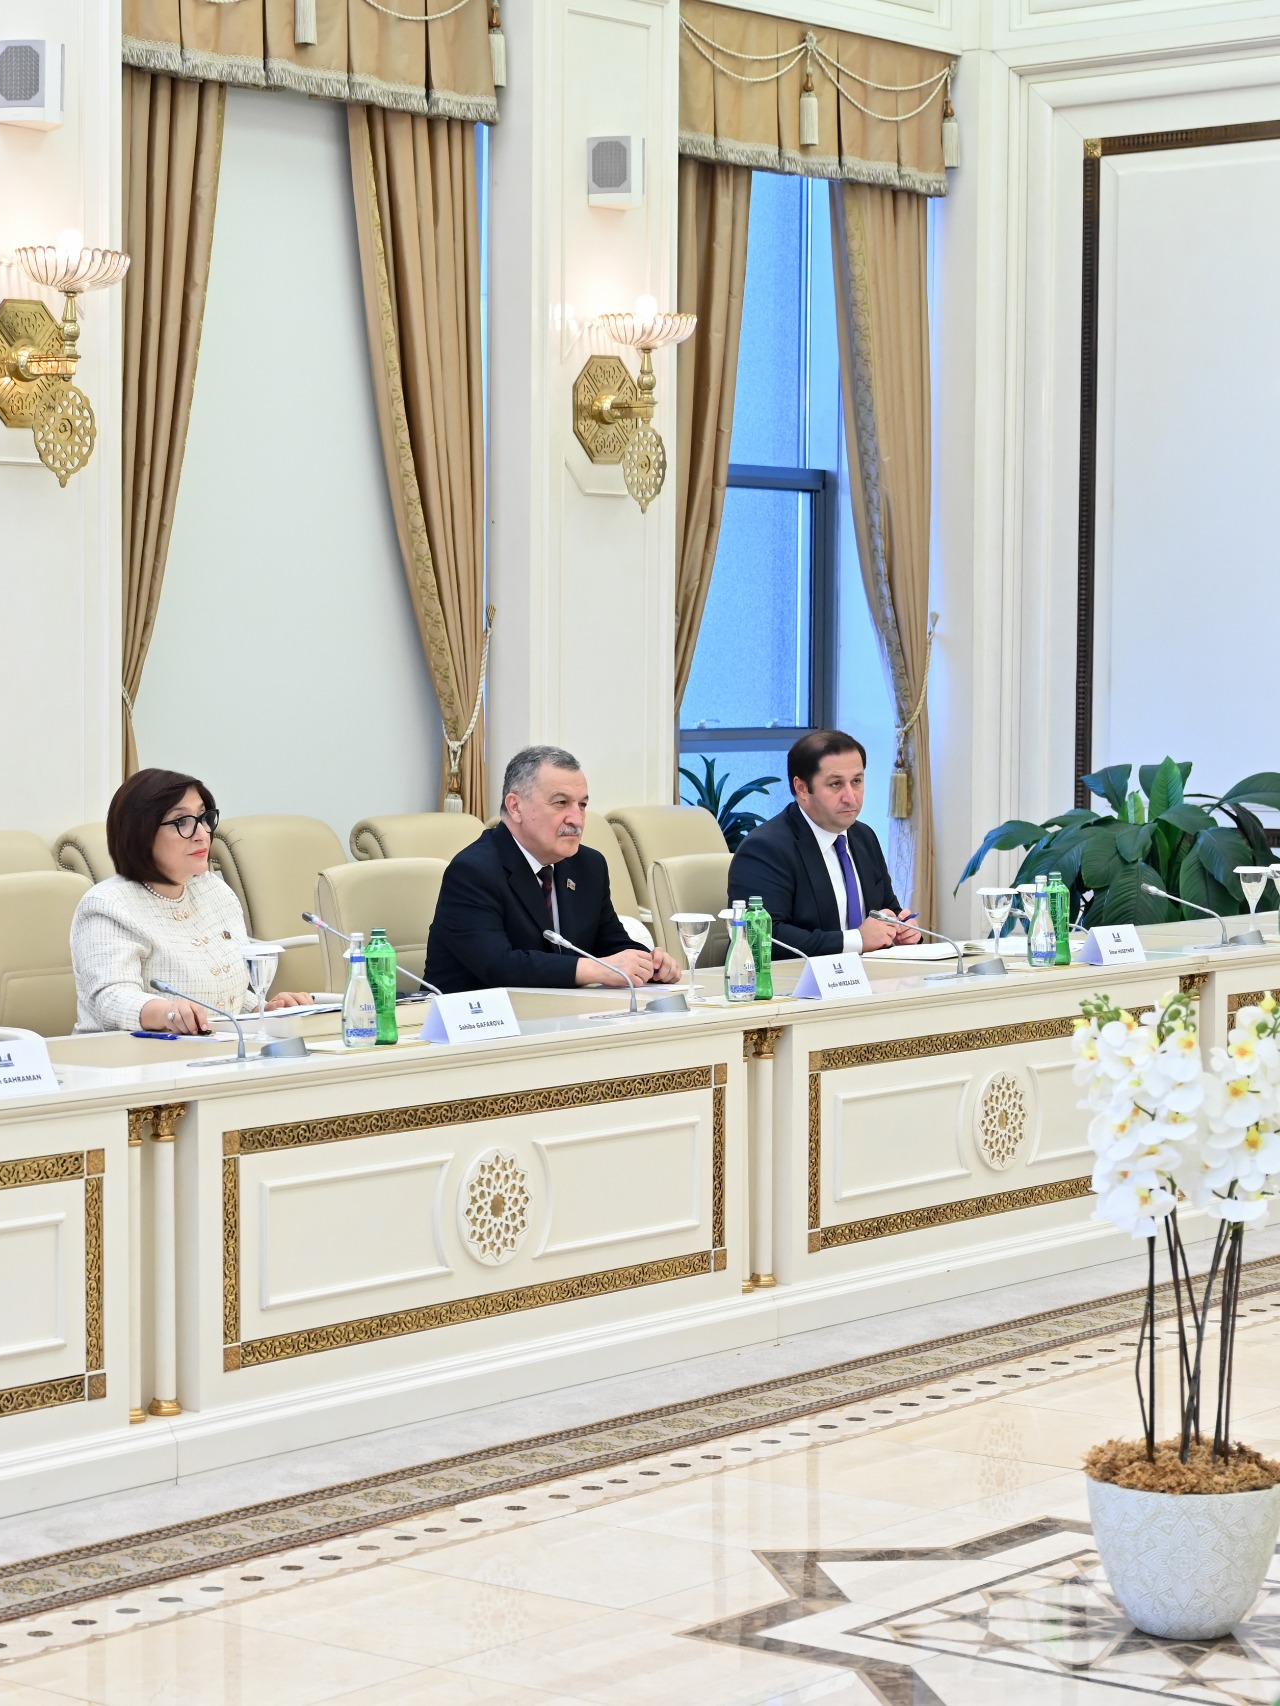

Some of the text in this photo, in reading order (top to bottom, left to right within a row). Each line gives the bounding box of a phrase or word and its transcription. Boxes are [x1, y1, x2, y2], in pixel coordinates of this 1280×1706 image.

[458, 1019, 505, 1031] Sahiba GAFAROVA
[2, 1074, 42, 1084] GAHRAMAN
